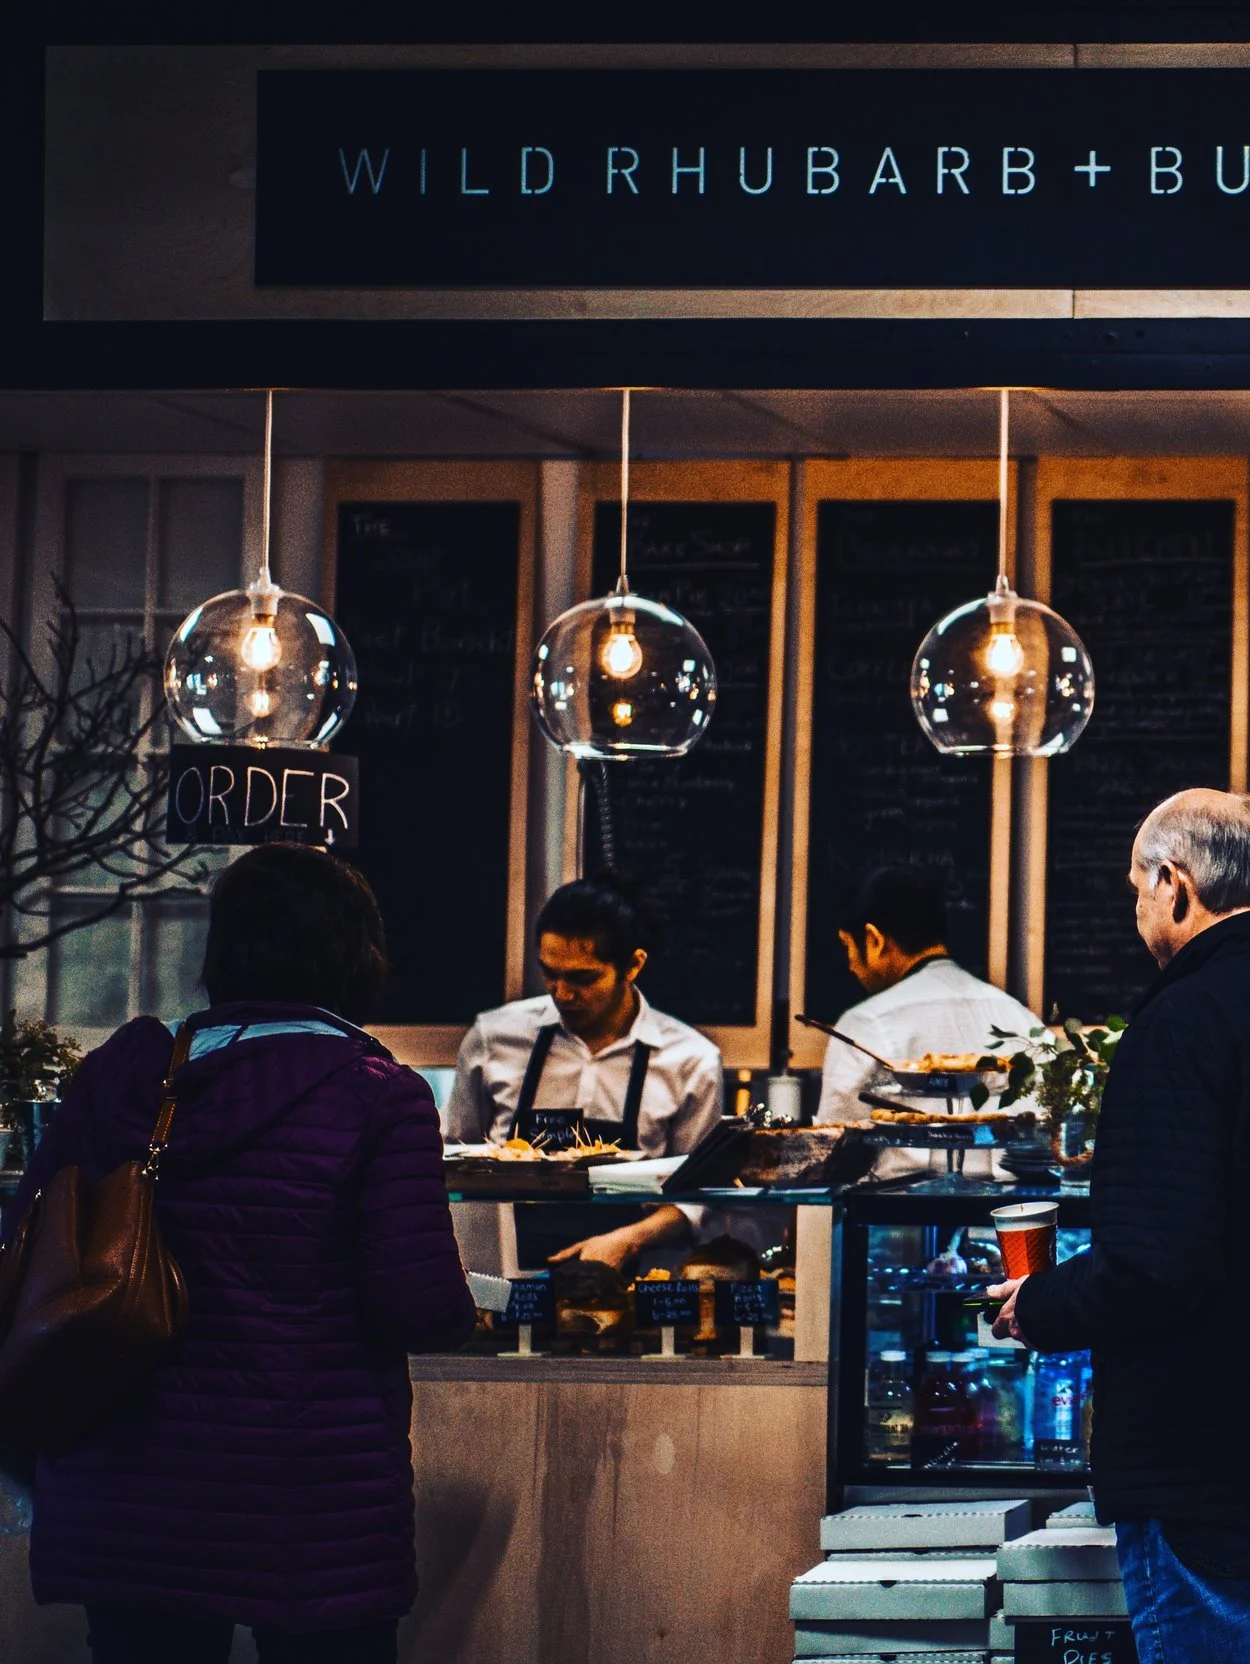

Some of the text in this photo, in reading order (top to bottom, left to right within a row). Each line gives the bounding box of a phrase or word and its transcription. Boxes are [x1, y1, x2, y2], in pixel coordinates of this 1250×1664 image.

[338, 147, 555, 195] WILD
[605, 147, 1037, 195] RHUBARB
[175, 765, 350, 830] ORDER
